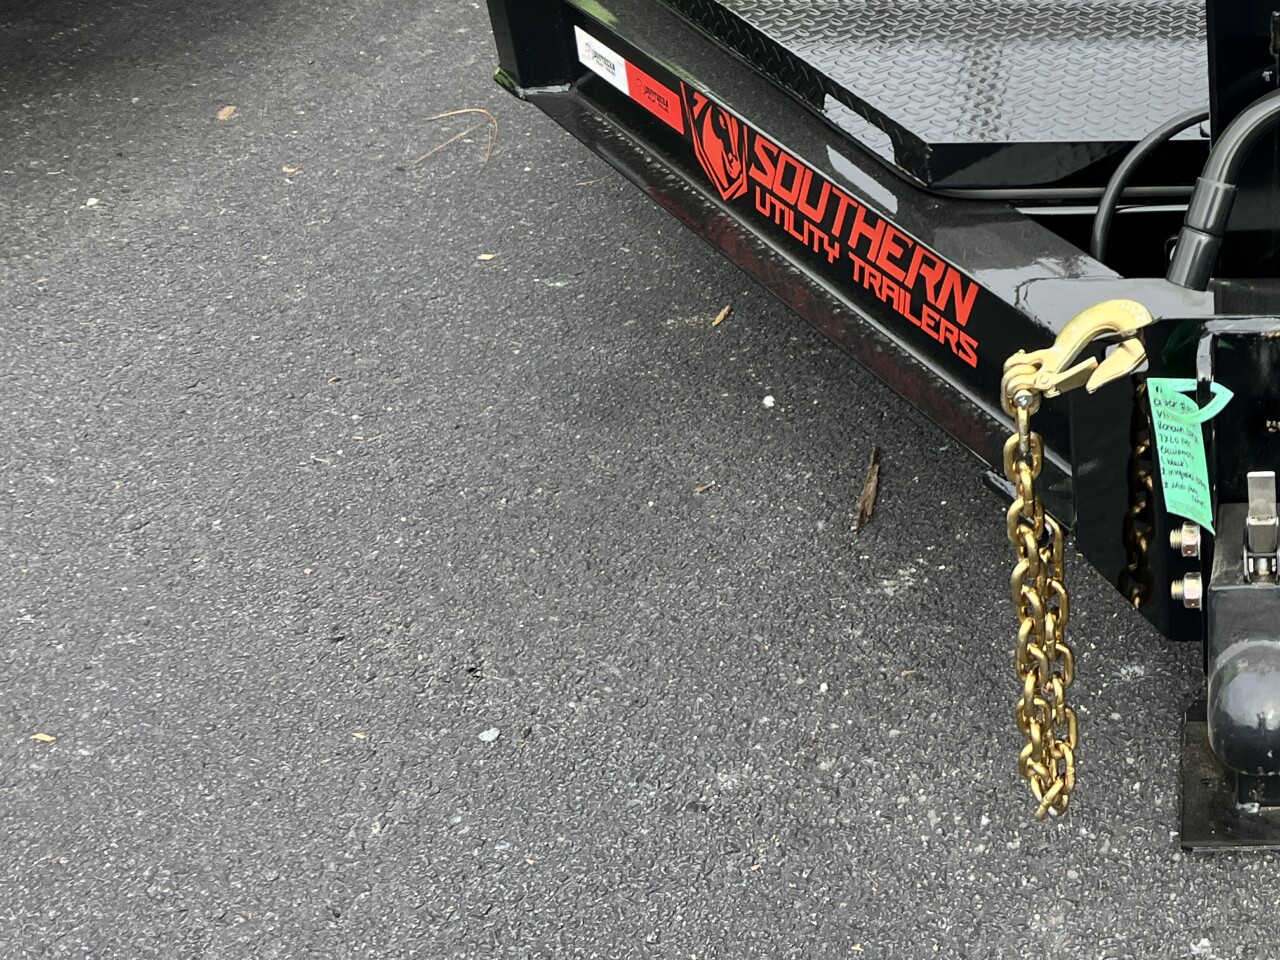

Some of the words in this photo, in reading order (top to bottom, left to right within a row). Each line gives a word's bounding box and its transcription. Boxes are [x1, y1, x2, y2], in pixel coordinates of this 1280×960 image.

[748, 134, 979, 327] SOUTHERN
[755, 186, 840, 263] UTILITY
[848, 251, 979, 368] TRAILERS
